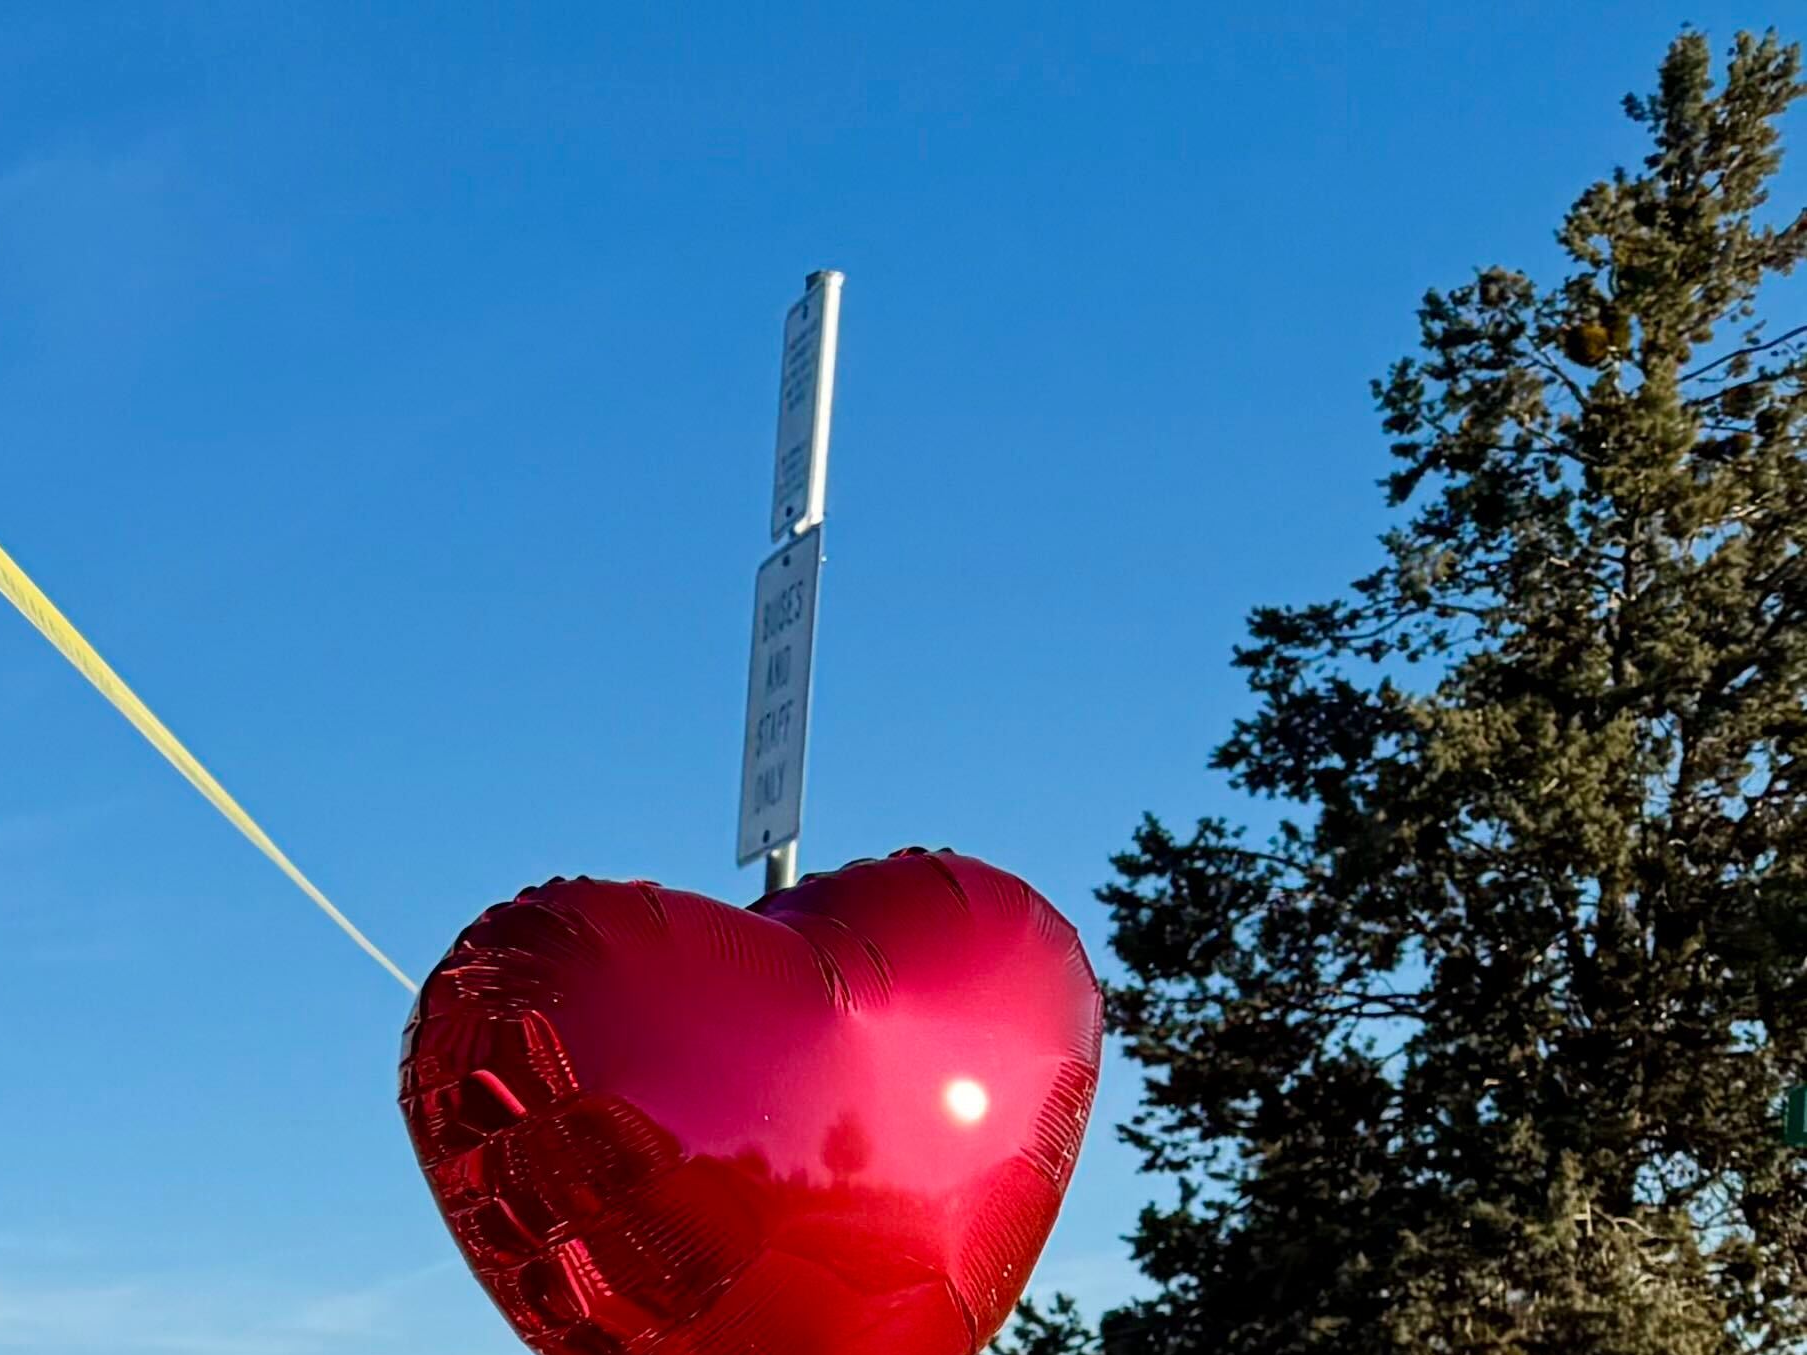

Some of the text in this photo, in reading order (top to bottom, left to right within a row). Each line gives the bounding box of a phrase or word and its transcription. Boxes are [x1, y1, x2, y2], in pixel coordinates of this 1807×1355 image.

[763, 579, 804, 642] BUSES
[766, 644, 791, 692] AND
[756, 699, 793, 758] STAFF
[754, 761, 785, 815] ONLY
